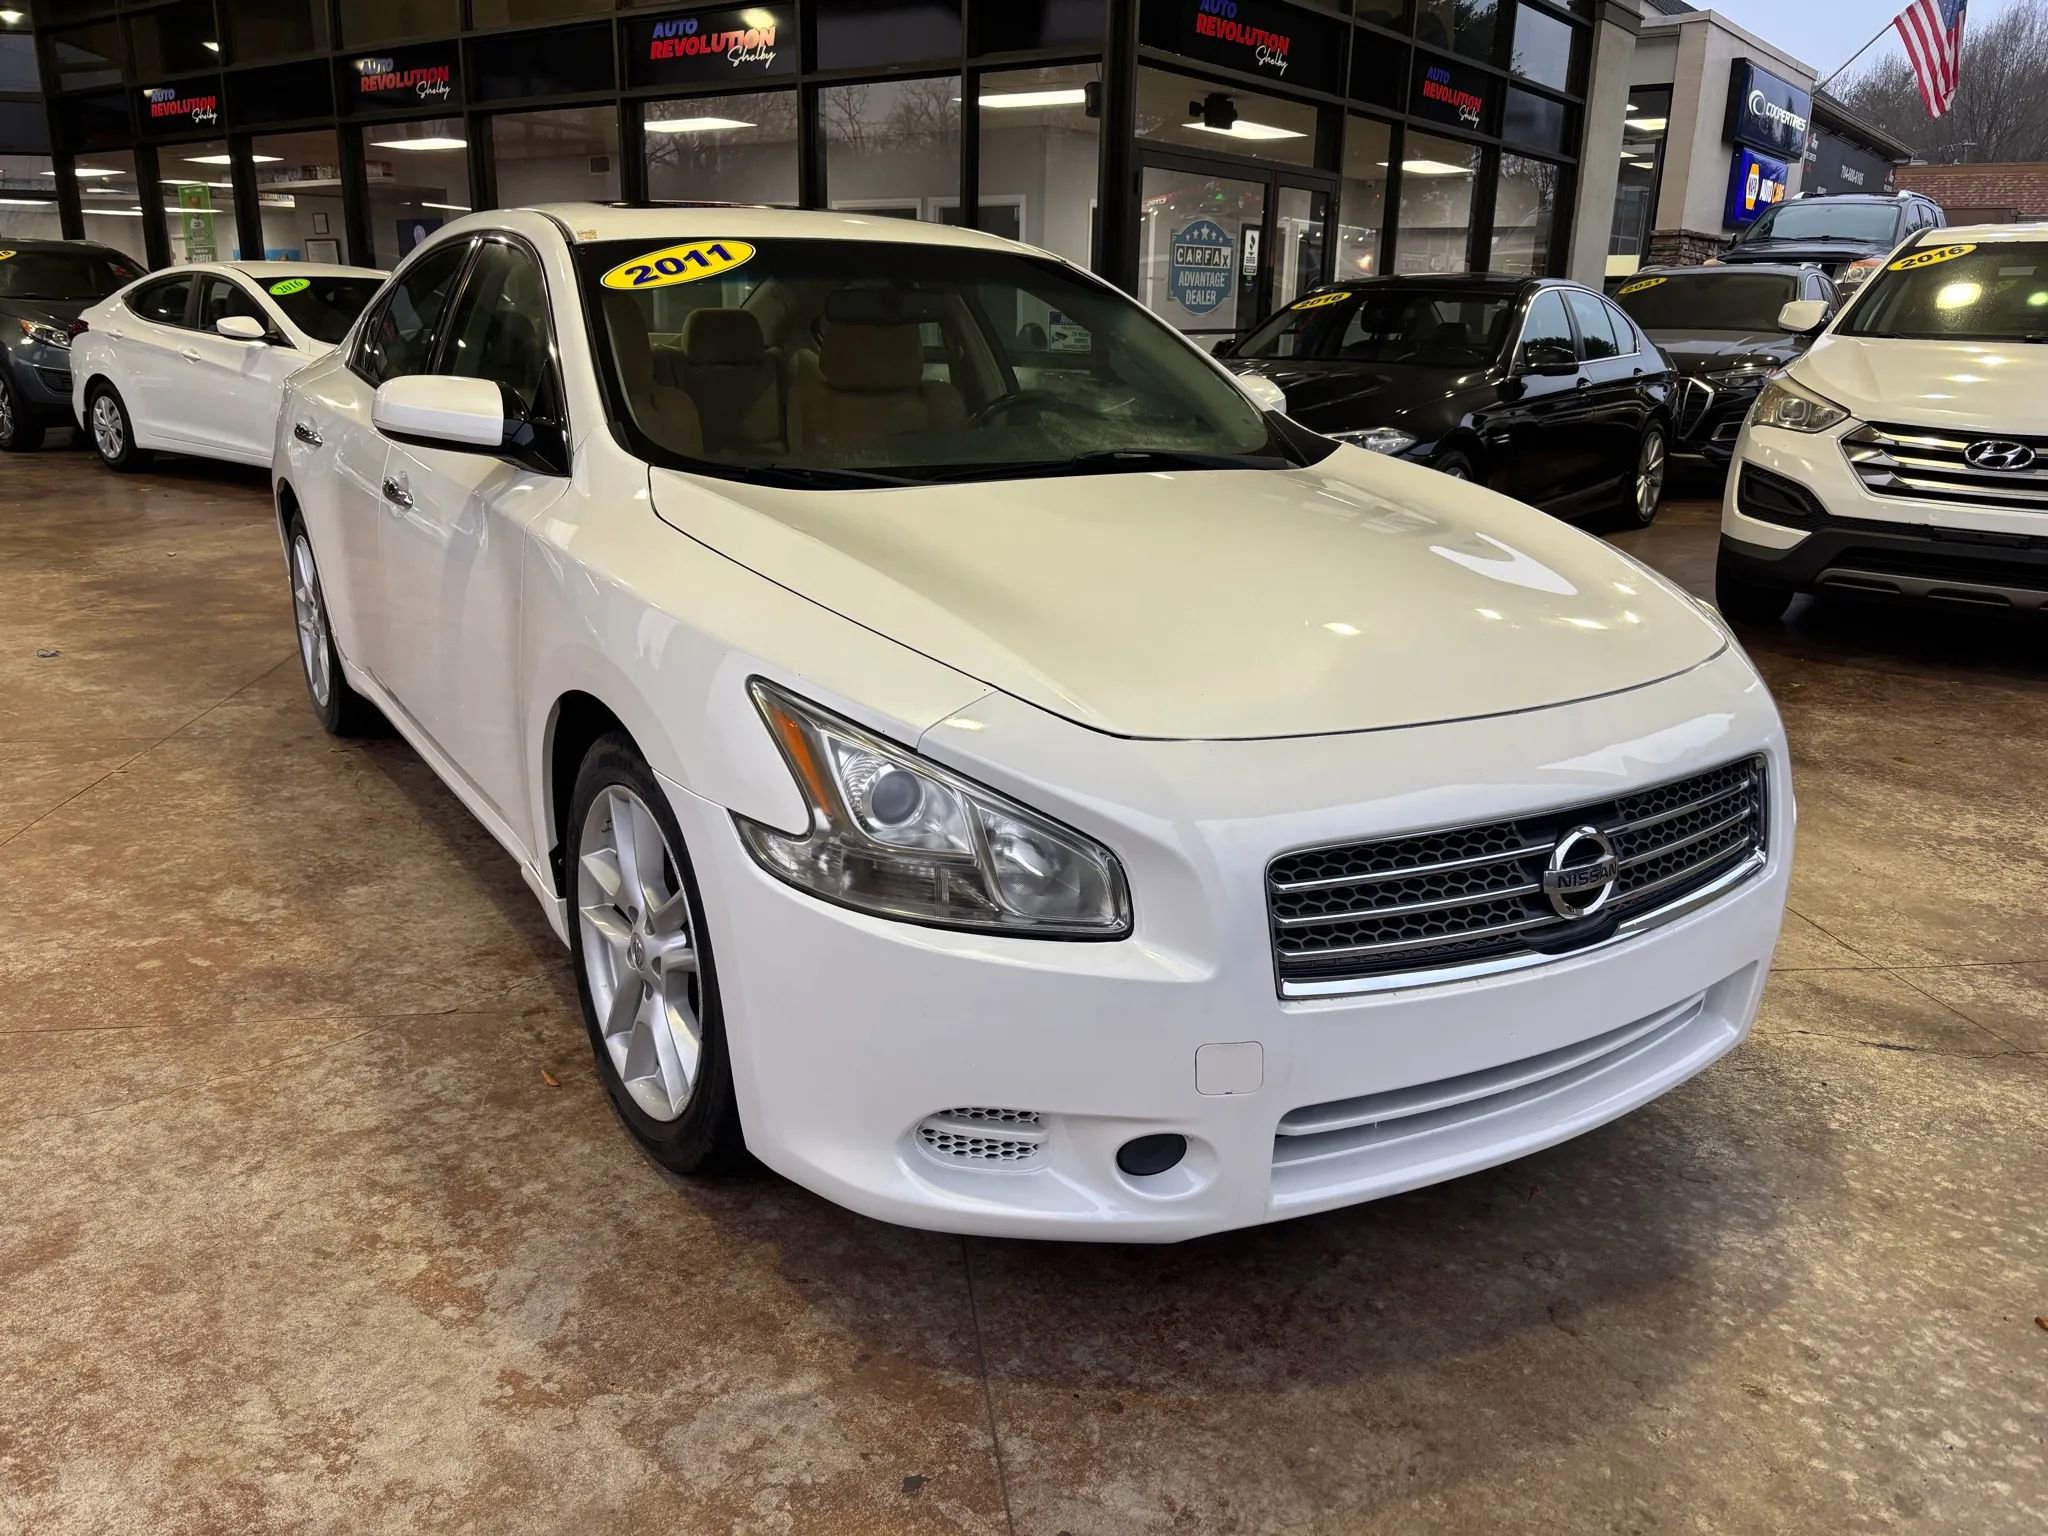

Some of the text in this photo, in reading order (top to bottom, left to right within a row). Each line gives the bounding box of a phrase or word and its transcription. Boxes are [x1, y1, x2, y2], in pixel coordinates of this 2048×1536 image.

[1201, 0, 1237, 18] AUTO
[653, 18, 698, 38] AUTO
[1196, 13, 1290, 55] REVOLUTION
[651, 26, 776, 59] REVOLUTION
[362, 58, 393, 75] AUTO
[727, 44, 776, 69] Shelby
[1256, 45, 1288, 76] Shelby
[361, 66, 449, 92] REVOLUTION
[1427, 66, 1450, 84] AUTO
[152, 88, 175, 103] AUTO
[416, 78, 450, 100] Shelby
[1424, 80, 1482, 112] REVOLUTION
[151, 96, 216, 117] REVOLUTION
[624, 244, 735, 286] 2011
[1177, 248, 1230, 268] CARFAX
[1900, 247, 1964, 269] 2016
[1185, 291, 1217, 305] DEALER
[1557, 861, 1618, 889] NISSAN
